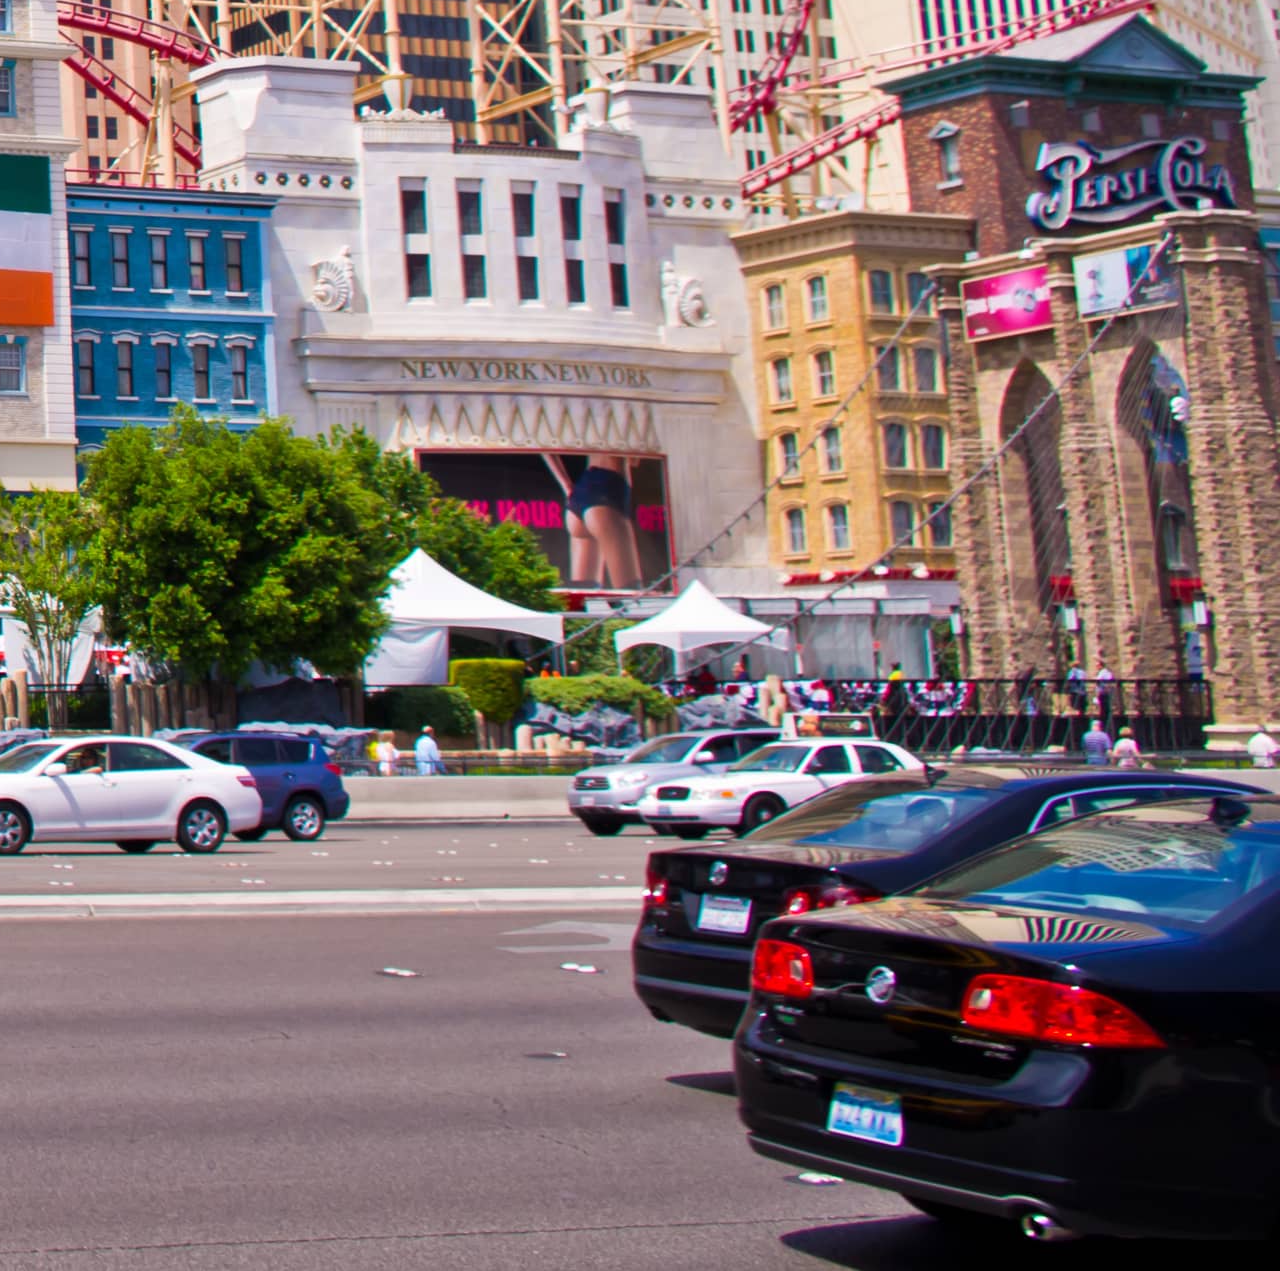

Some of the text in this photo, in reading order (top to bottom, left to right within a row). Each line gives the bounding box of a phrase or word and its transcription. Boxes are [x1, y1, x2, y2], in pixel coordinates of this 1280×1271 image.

[400, 360, 652, 387] NEW YORK NEW YORK
